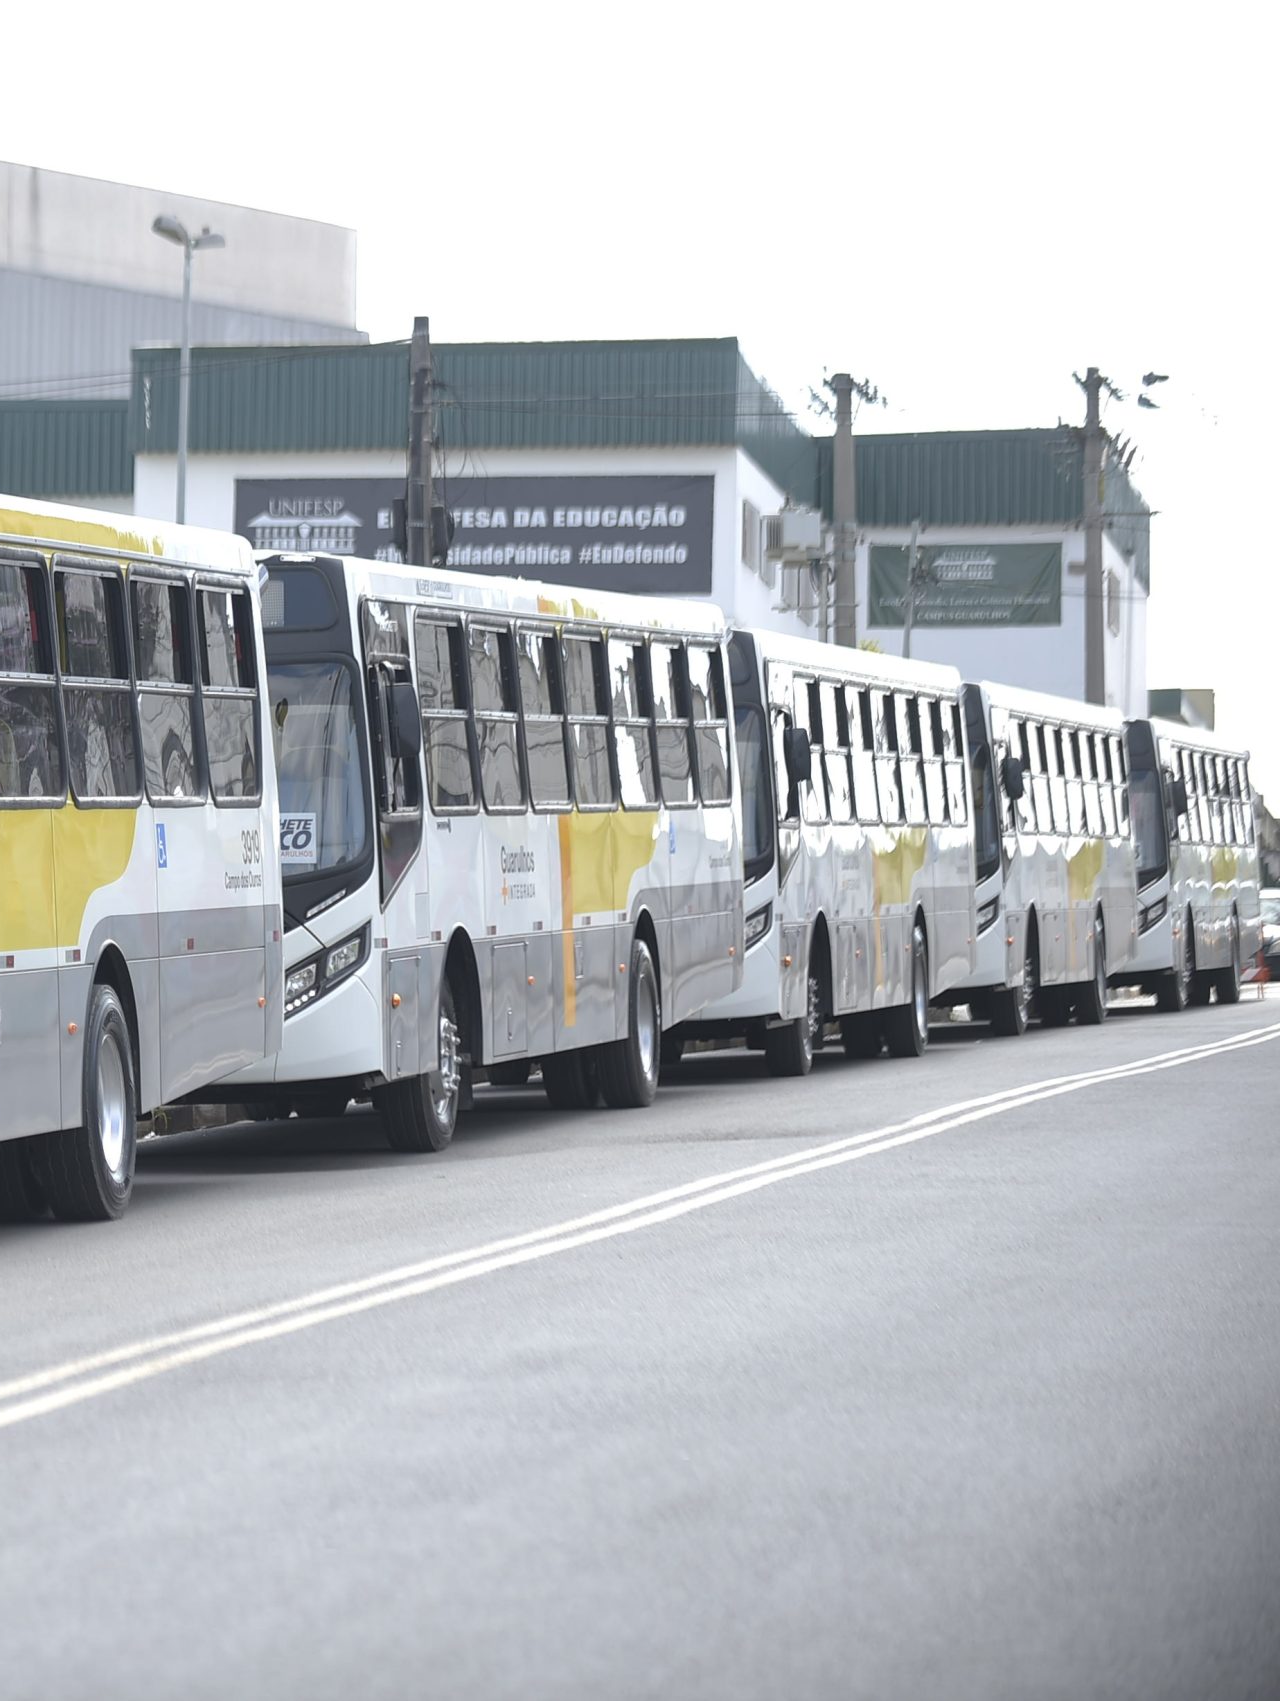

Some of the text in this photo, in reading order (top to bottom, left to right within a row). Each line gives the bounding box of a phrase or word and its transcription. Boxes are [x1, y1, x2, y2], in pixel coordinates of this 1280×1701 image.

[270, 497, 345, 517] UNIFESP
[376, 502, 688, 531] E FESA DA EDUCAÇÃO
[578, 543, 689, 566] #EuDefendo
[241, 830, 261, 865] 3919
